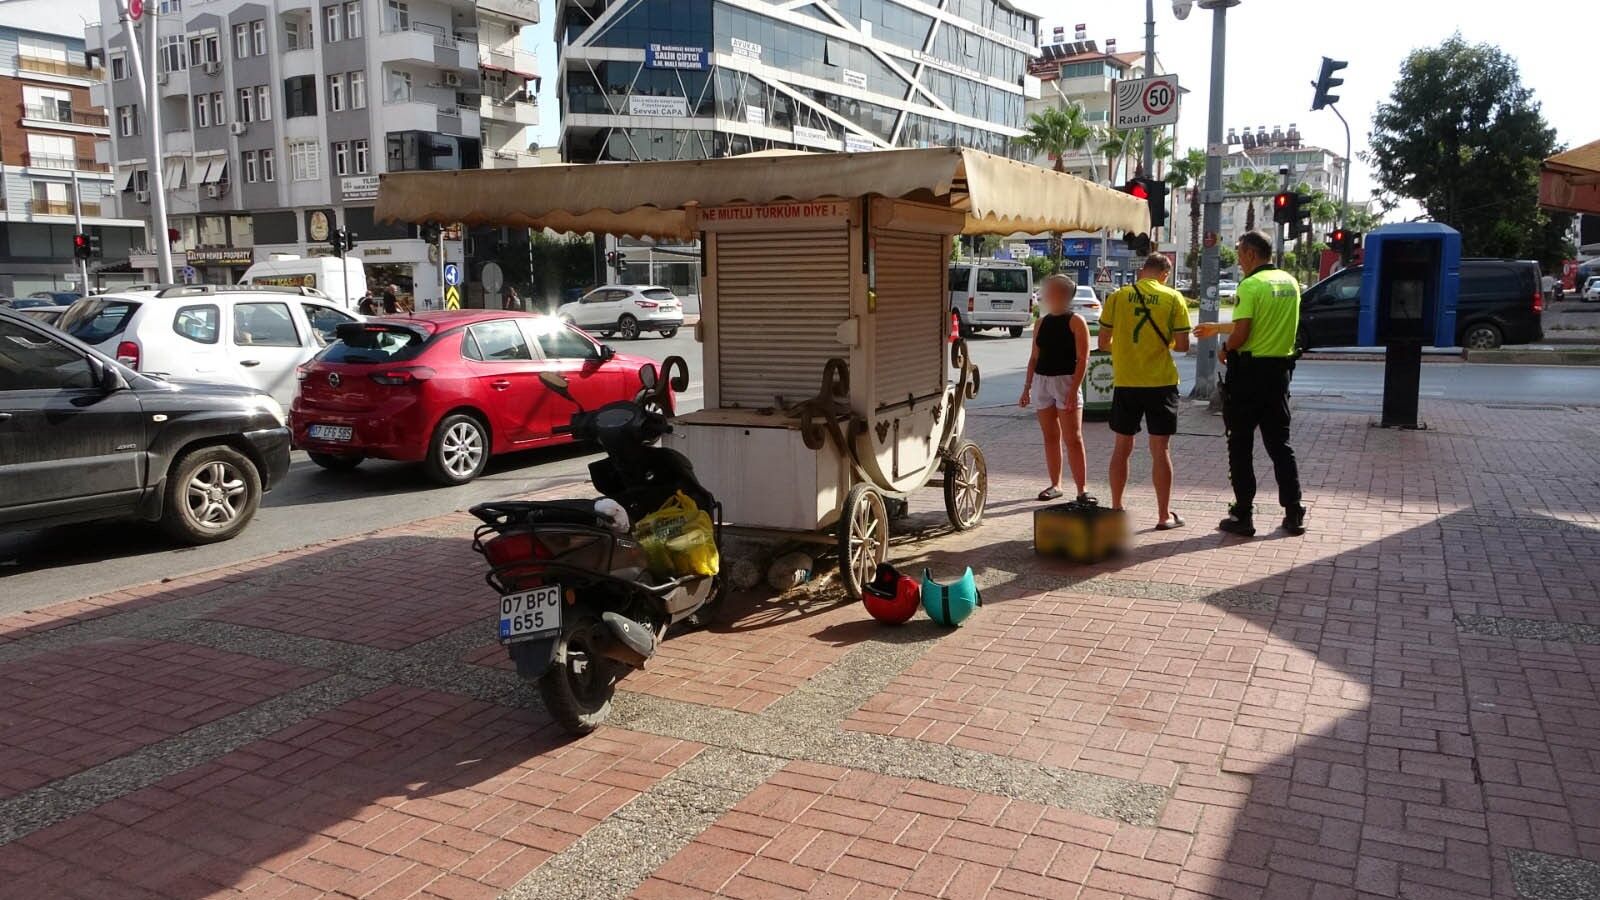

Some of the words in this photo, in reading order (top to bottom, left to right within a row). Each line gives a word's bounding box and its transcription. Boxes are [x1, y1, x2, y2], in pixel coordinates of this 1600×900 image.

[1150, 88, 1168, 107] 50
[1119, 114, 1151, 124] Radar
[702, 209, 715, 221] NE
[718, 207, 753, 220] MUTLU
[1134, 307, 1149, 343] 7
[502, 597, 522, 614] 07
[526, 589, 557, 610] BPC
[513, 611, 544, 631] 655
